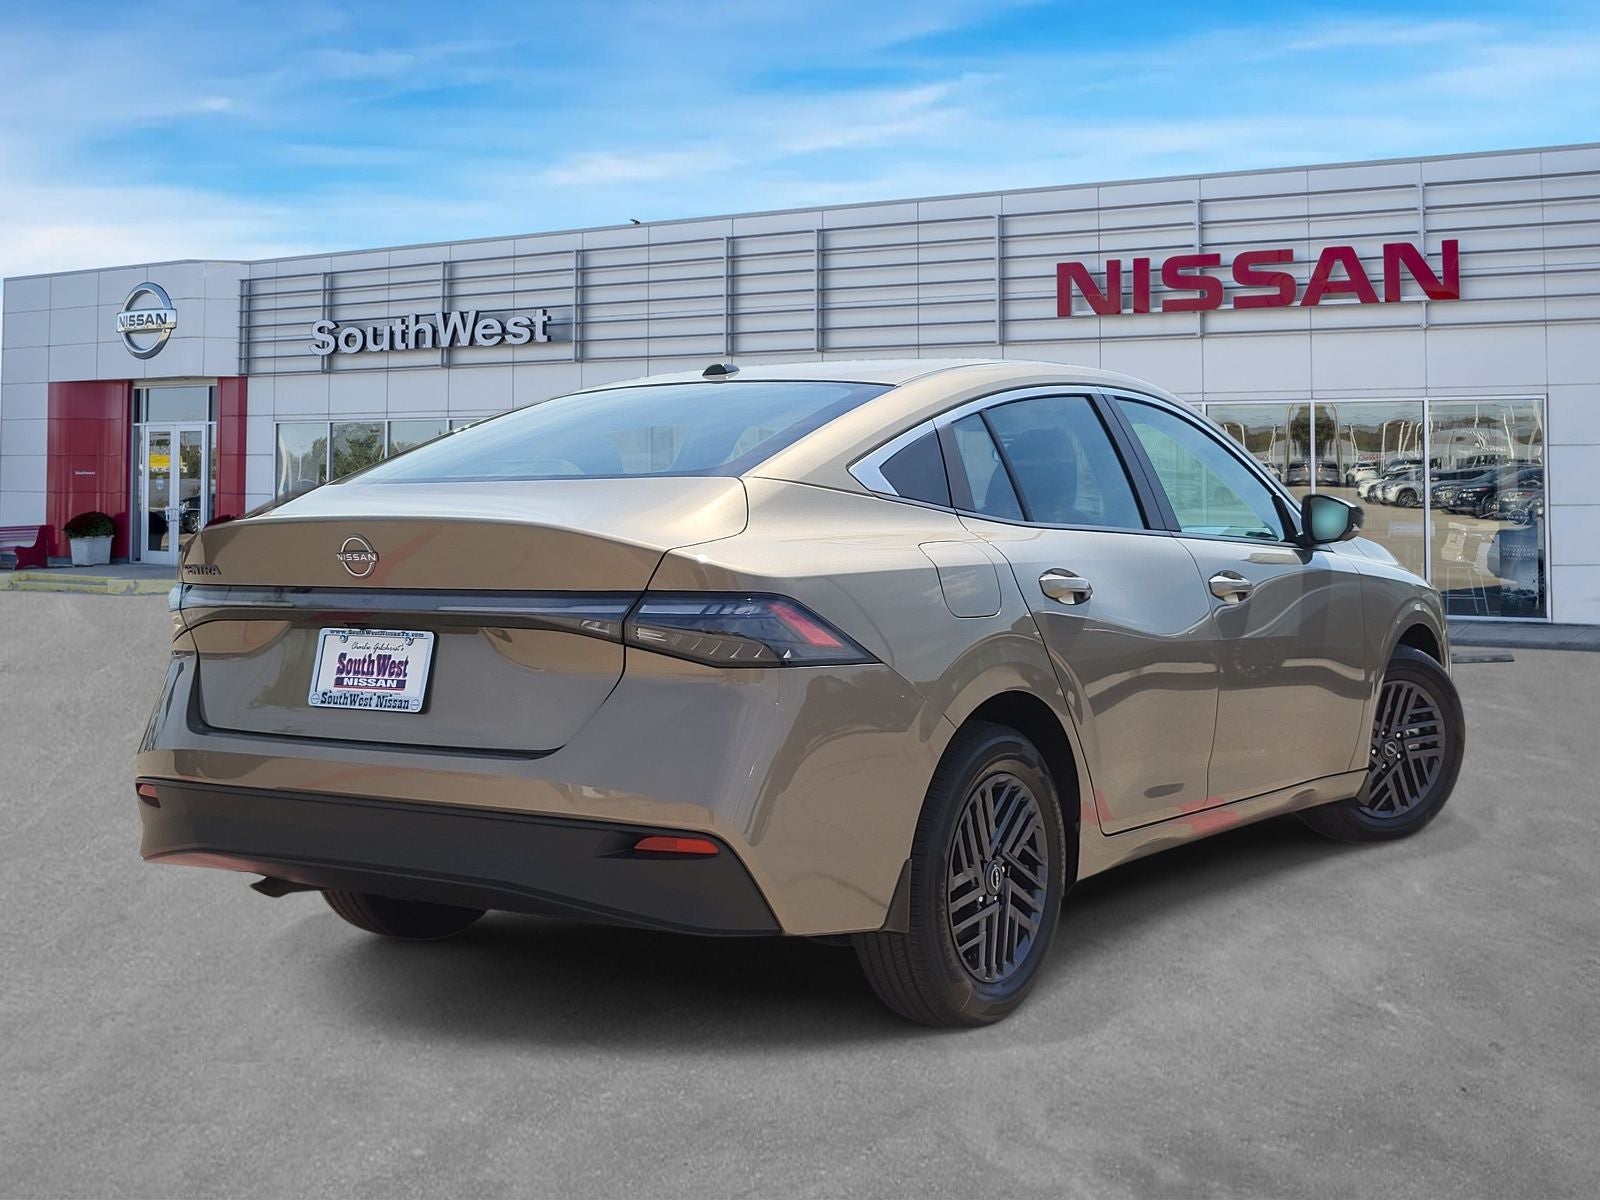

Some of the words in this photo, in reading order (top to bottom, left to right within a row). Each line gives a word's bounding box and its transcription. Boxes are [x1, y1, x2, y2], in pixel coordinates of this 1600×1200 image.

[1056, 239, 1460, 317] NISSAN
[118, 312, 168, 328] NISSAN
[311, 309, 551, 355] SouthWest
[336, 552, 376, 561] NISSAN
[343, 677, 398, 688] NISSAN
[375, 694, 409, 710] Nissan
